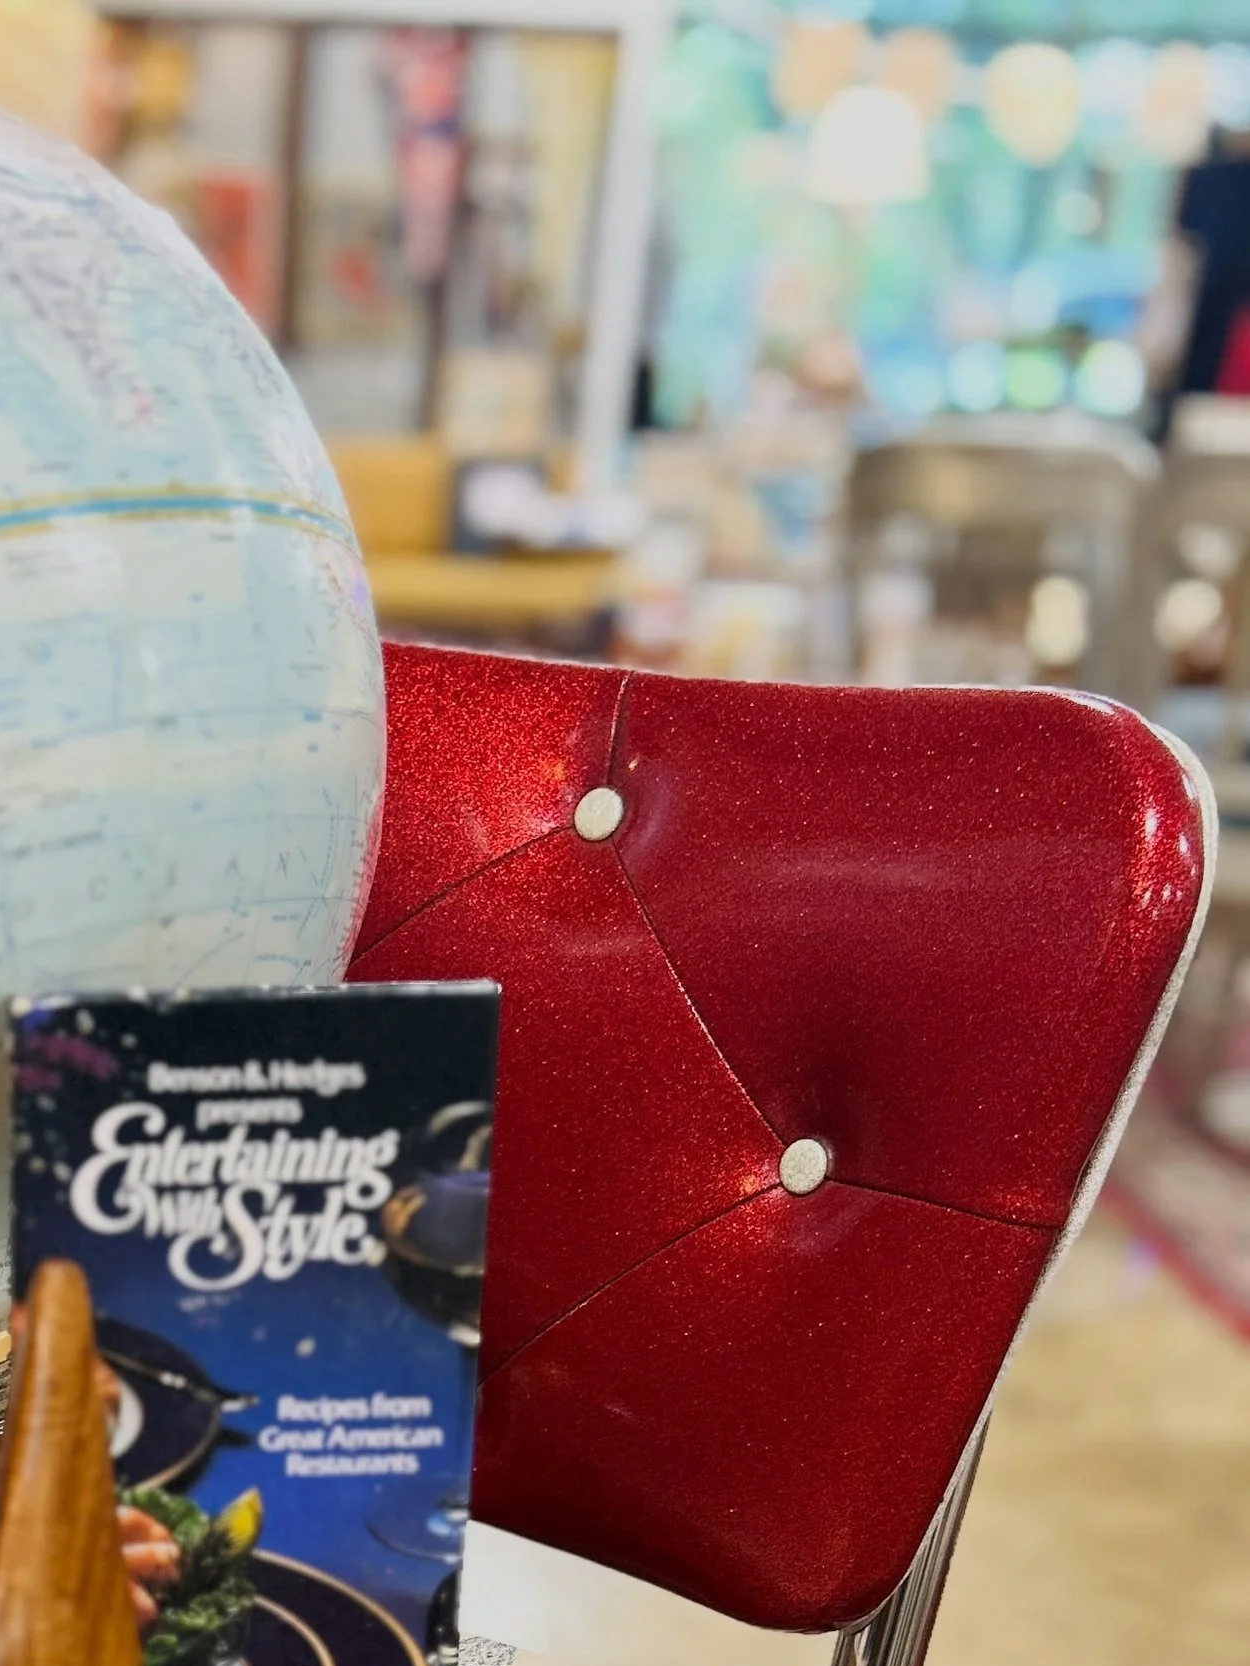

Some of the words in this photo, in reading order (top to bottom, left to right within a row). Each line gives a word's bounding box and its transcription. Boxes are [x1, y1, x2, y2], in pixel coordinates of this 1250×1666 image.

[146, 1062, 241, 1092] Benson
[243, 1060, 267, 1090] &
[268, 1059, 365, 1096] Hedges
[195, 1098, 303, 1131] presents
[70, 1101, 400, 1234] Entertaining
[114, 1184, 223, 1239] With
[167, 1182, 372, 1290] Style
[277, 1395, 368, 1425] Recipes
[371, 1392, 432, 1419] from
[258, 1426, 326, 1452] Great
[327, 1425, 444, 1450] American
[285, 1453, 420, 1477] Restaurants
